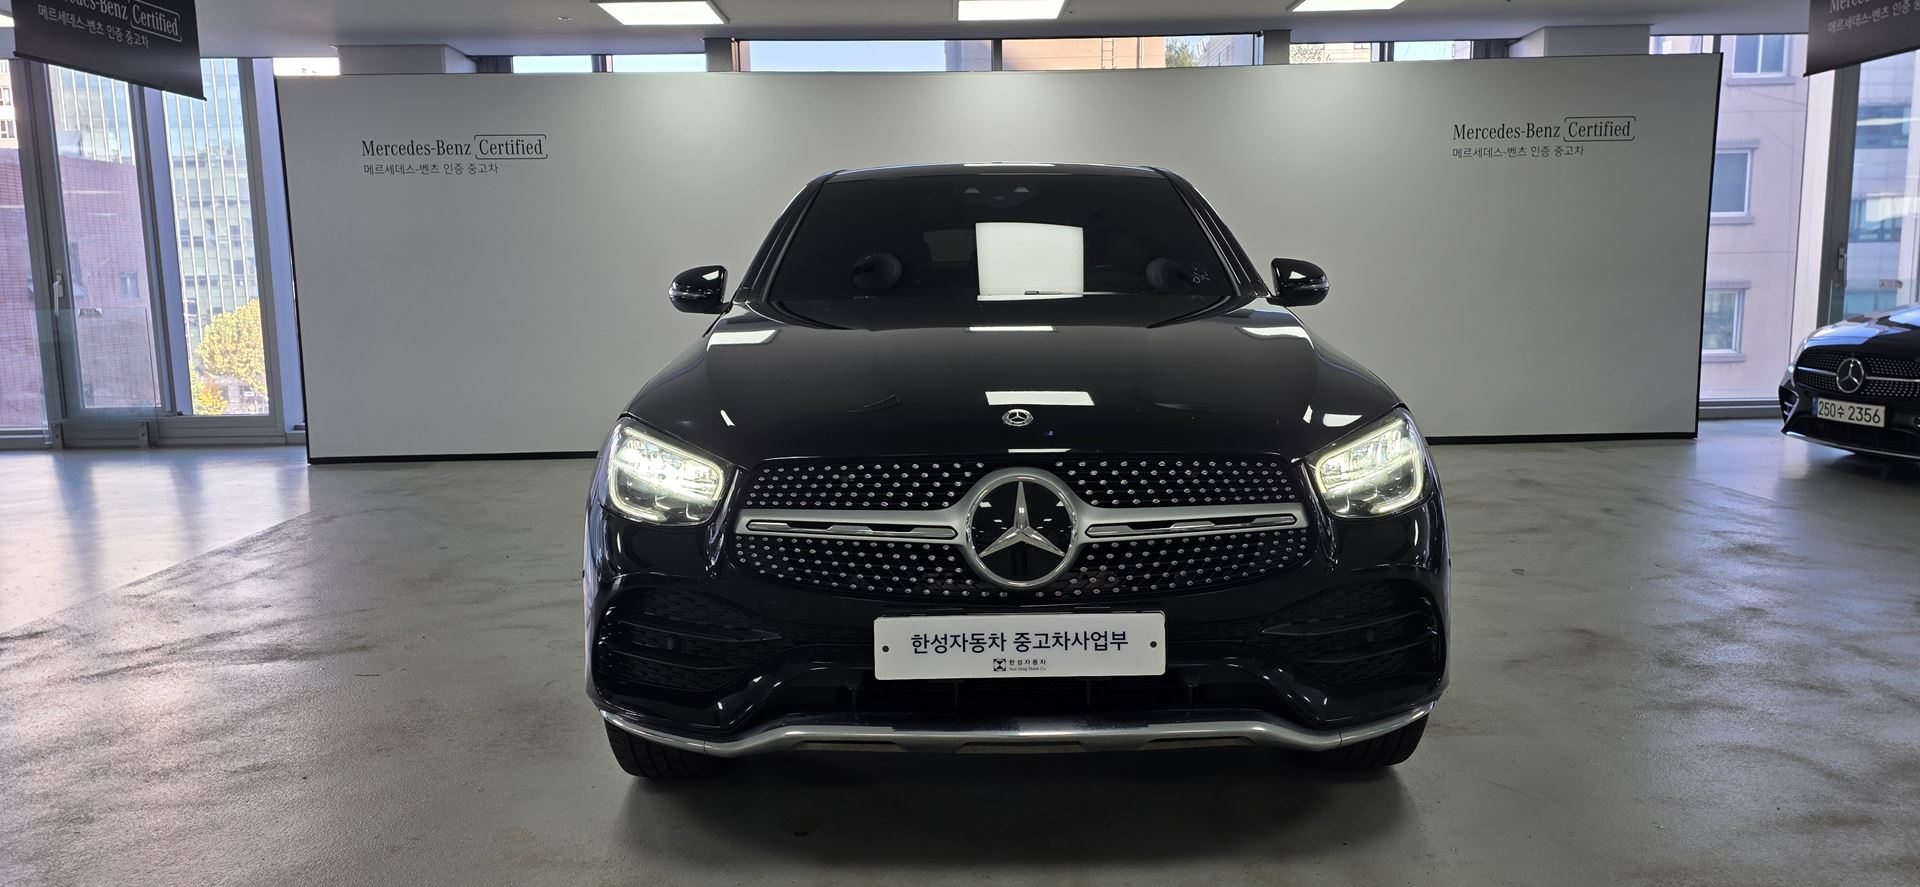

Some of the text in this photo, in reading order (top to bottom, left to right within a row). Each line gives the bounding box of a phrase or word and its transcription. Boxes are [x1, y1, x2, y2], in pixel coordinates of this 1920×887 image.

[37, 4, 149, 48] 메르세데스-벤츠 인증 중고차
[132, 4, 178, 36] Certified
[1453, 120, 1631, 140] Mercedes-Benz Certified
[362, 138, 543, 157] Mercedes-Benz Certified
[1452, 145, 1585, 159] 메르세데스-벤츠 인증 중고차
[363, 163, 499, 175] 메르세데스-벤츠 인증 중고차
[1818, 401, 1881, 424] 250수 2356
[911, 631, 1129, 654] 한성자동차 중고차사업부
